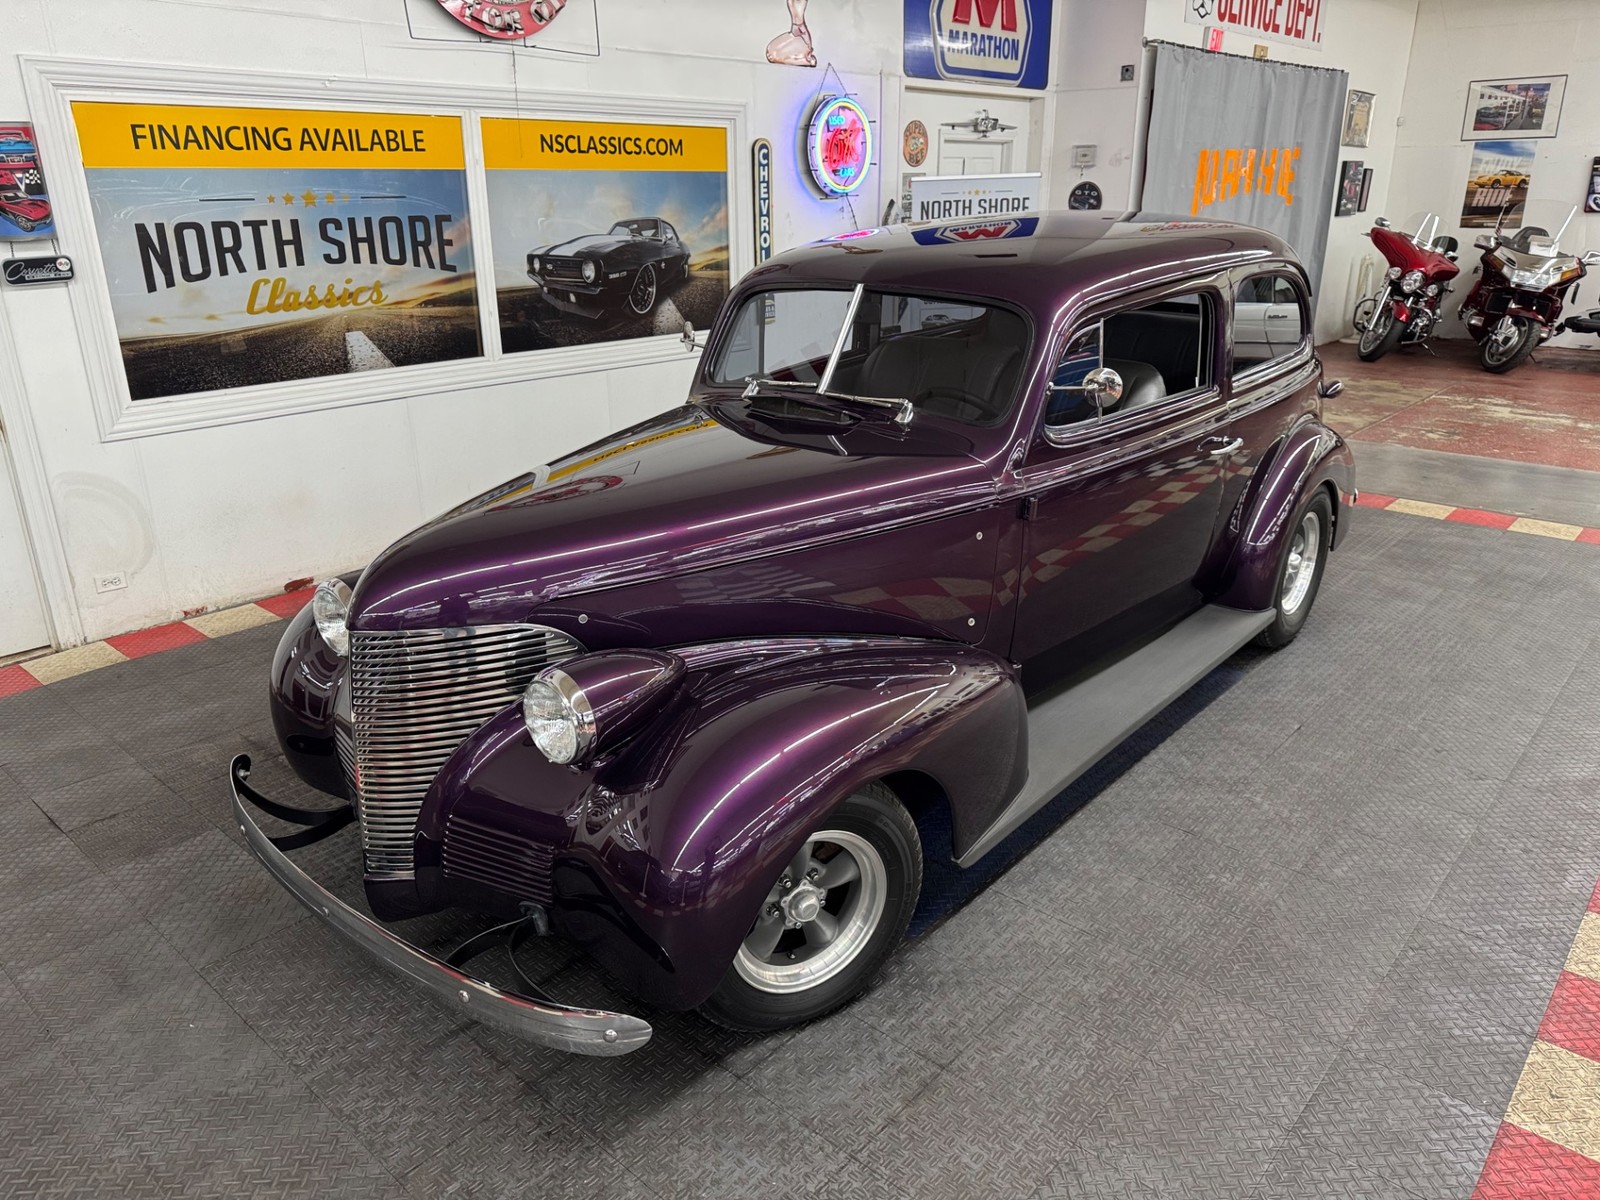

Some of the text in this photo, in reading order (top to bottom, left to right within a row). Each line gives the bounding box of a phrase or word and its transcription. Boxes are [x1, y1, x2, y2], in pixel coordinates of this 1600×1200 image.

[1284, 0, 1322, 43] DEPT.
[946, 29, 1020, 61] MARATHON
[130, 124, 426, 152] FINANCING AVAILABLE
[540, 134, 683, 156] NSCLASSICS.COM
[759, 148, 770, 263] CHEVROL
[920, 198, 972, 221] NORTH
[134, 214, 457, 294] NORTH SHORE
[246, 276, 388, 315] Classics
